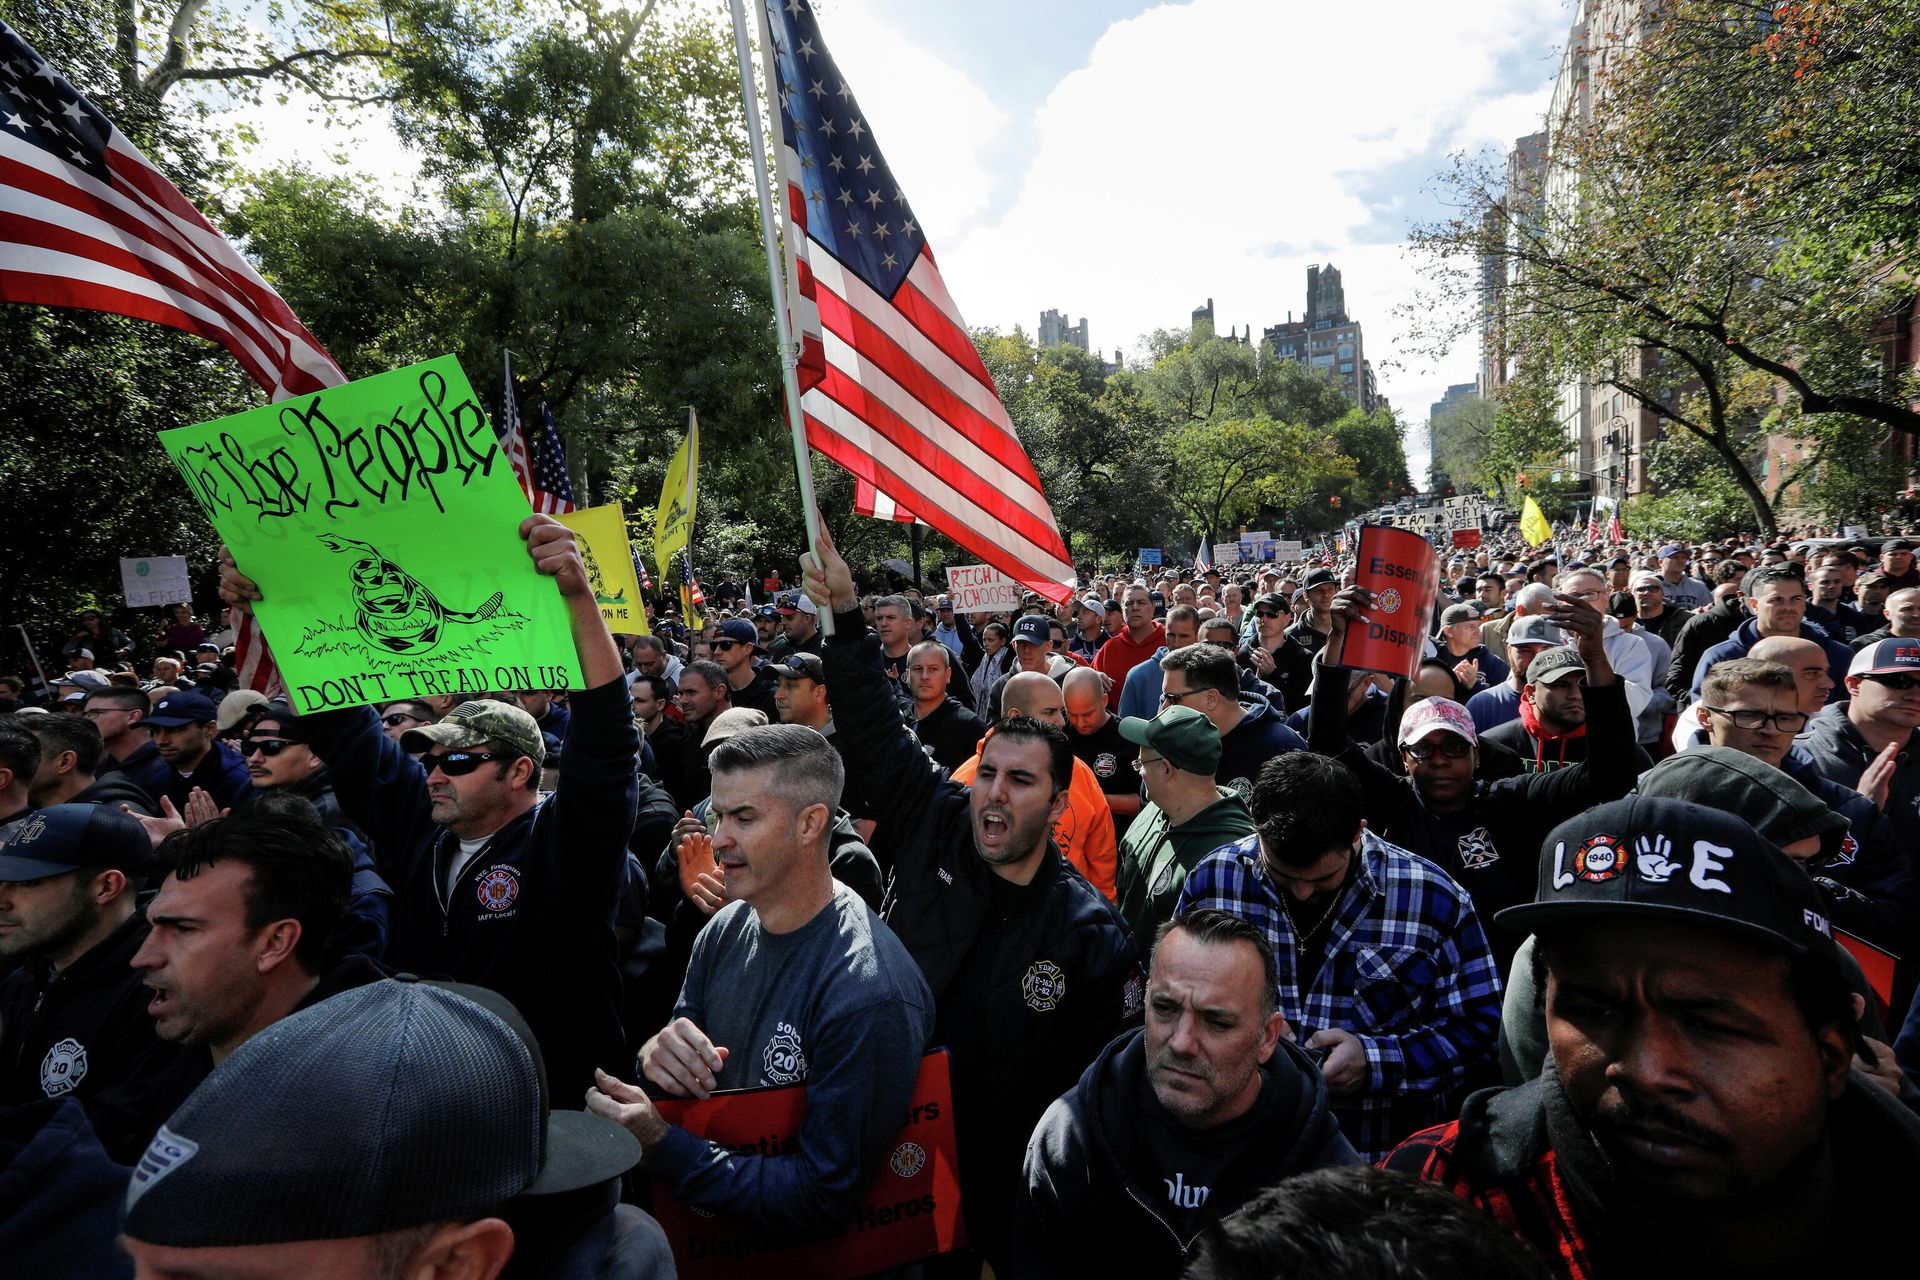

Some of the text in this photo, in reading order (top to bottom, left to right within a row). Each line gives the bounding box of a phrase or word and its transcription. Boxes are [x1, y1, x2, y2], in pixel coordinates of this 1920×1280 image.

[208, 432, 313, 524] the
[279, 370, 498, 520] People
[1446, 494, 1481, 509] I AM
[1446, 506, 1480, 519] VERY
[1397, 514, 1426, 526] I AM
[1447, 517, 1481, 530] UPSET
[1369, 557, 1422, 582] Essen
[602, 608, 629, 619] ON ME
[1020, 622, 1035, 632] 162
[1544, 650, 1580, 668] FDN
[297, 665, 570, 712] DON'T TREAD ON US
[1588, 852, 1613, 863] 1940
[478, 913, 494, 921] IAFF
[494, 910, 513, 919] Local
[1038, 964, 1056, 974] FDNY
[1034, 976, 1054, 989] E-162
[773, 1051, 796, 1071] 20
[52, 1061, 69, 1075] 30
